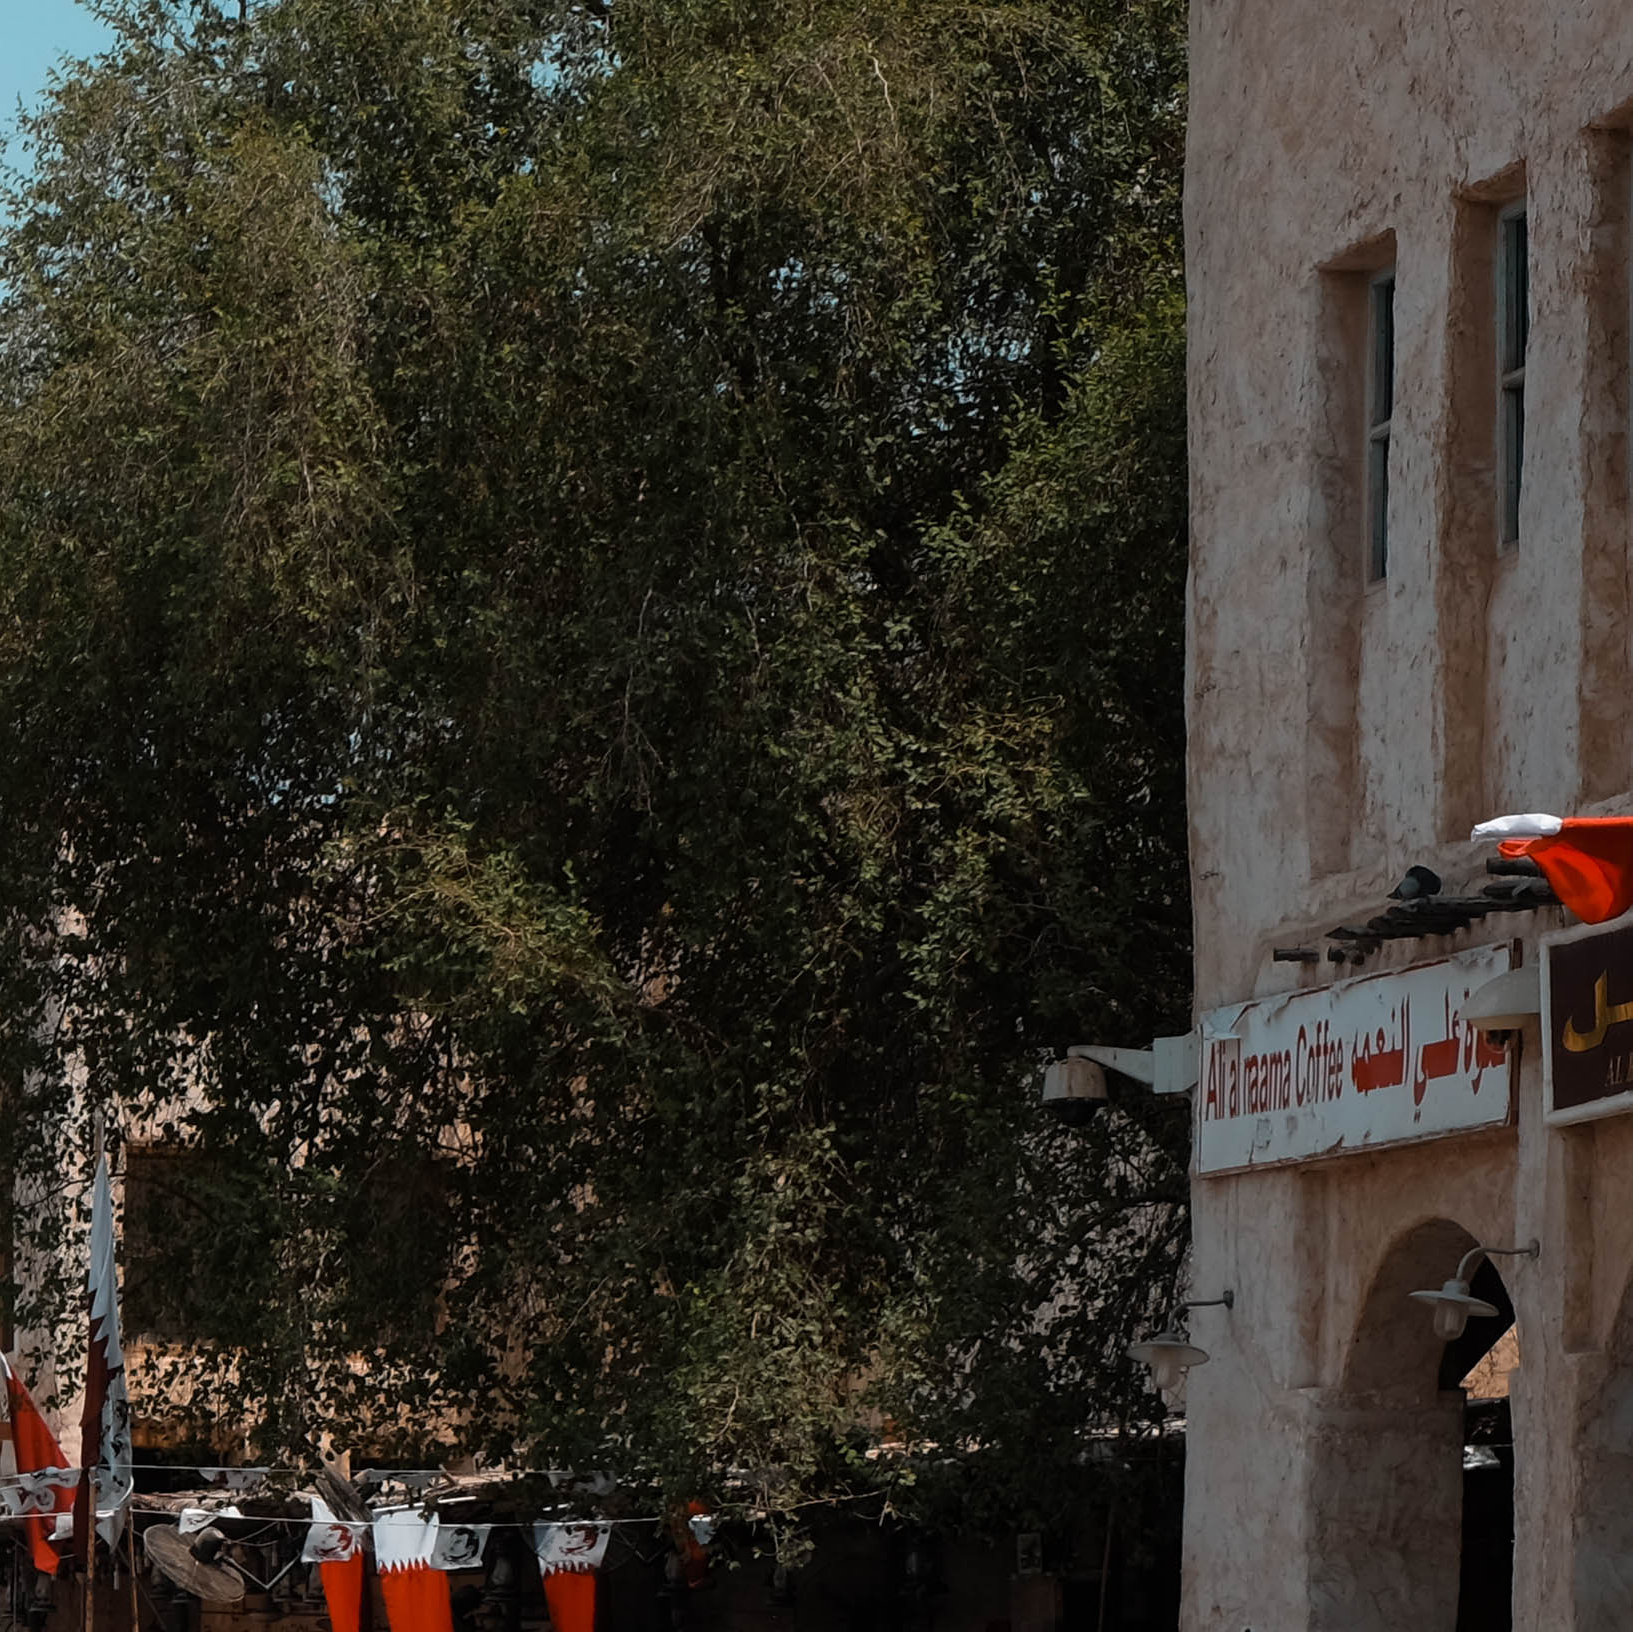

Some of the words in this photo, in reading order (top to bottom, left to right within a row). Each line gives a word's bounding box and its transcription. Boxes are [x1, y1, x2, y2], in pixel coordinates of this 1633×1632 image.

[1205, 1040, 1226, 1121] Ali
[1229, 1038, 1241, 1119] al
[1244, 1049, 1292, 1115] naama
[1295, 1019, 1344, 1108] Coffee
[1412, 984, 1460, 1124] علي
